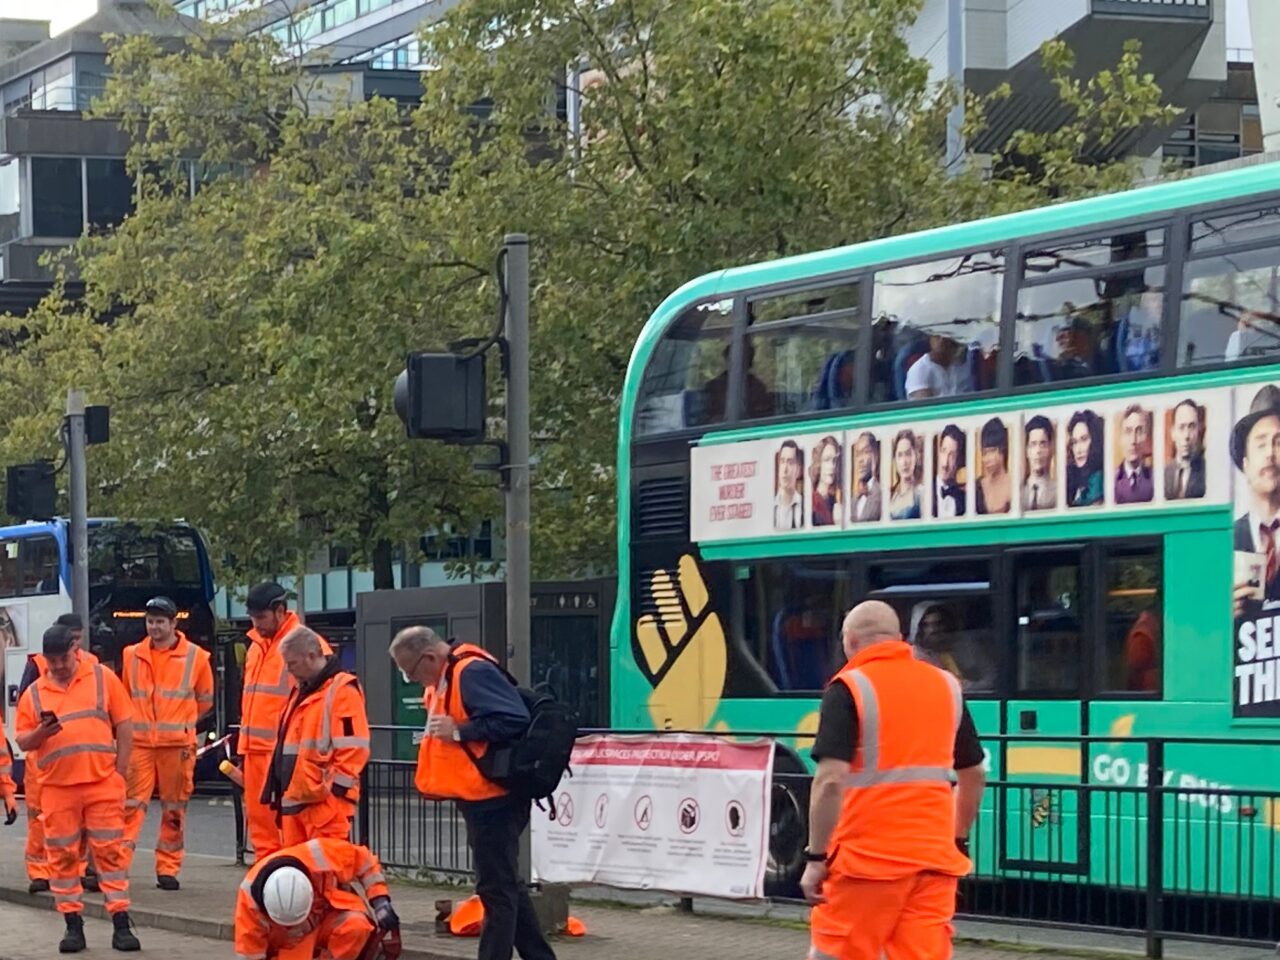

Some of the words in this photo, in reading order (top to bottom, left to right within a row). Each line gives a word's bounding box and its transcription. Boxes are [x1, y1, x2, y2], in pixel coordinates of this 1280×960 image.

[1235, 658, 1280, 706] TH
[1093, 754, 1131, 786] GO
[1178, 773, 1234, 814] BUS
